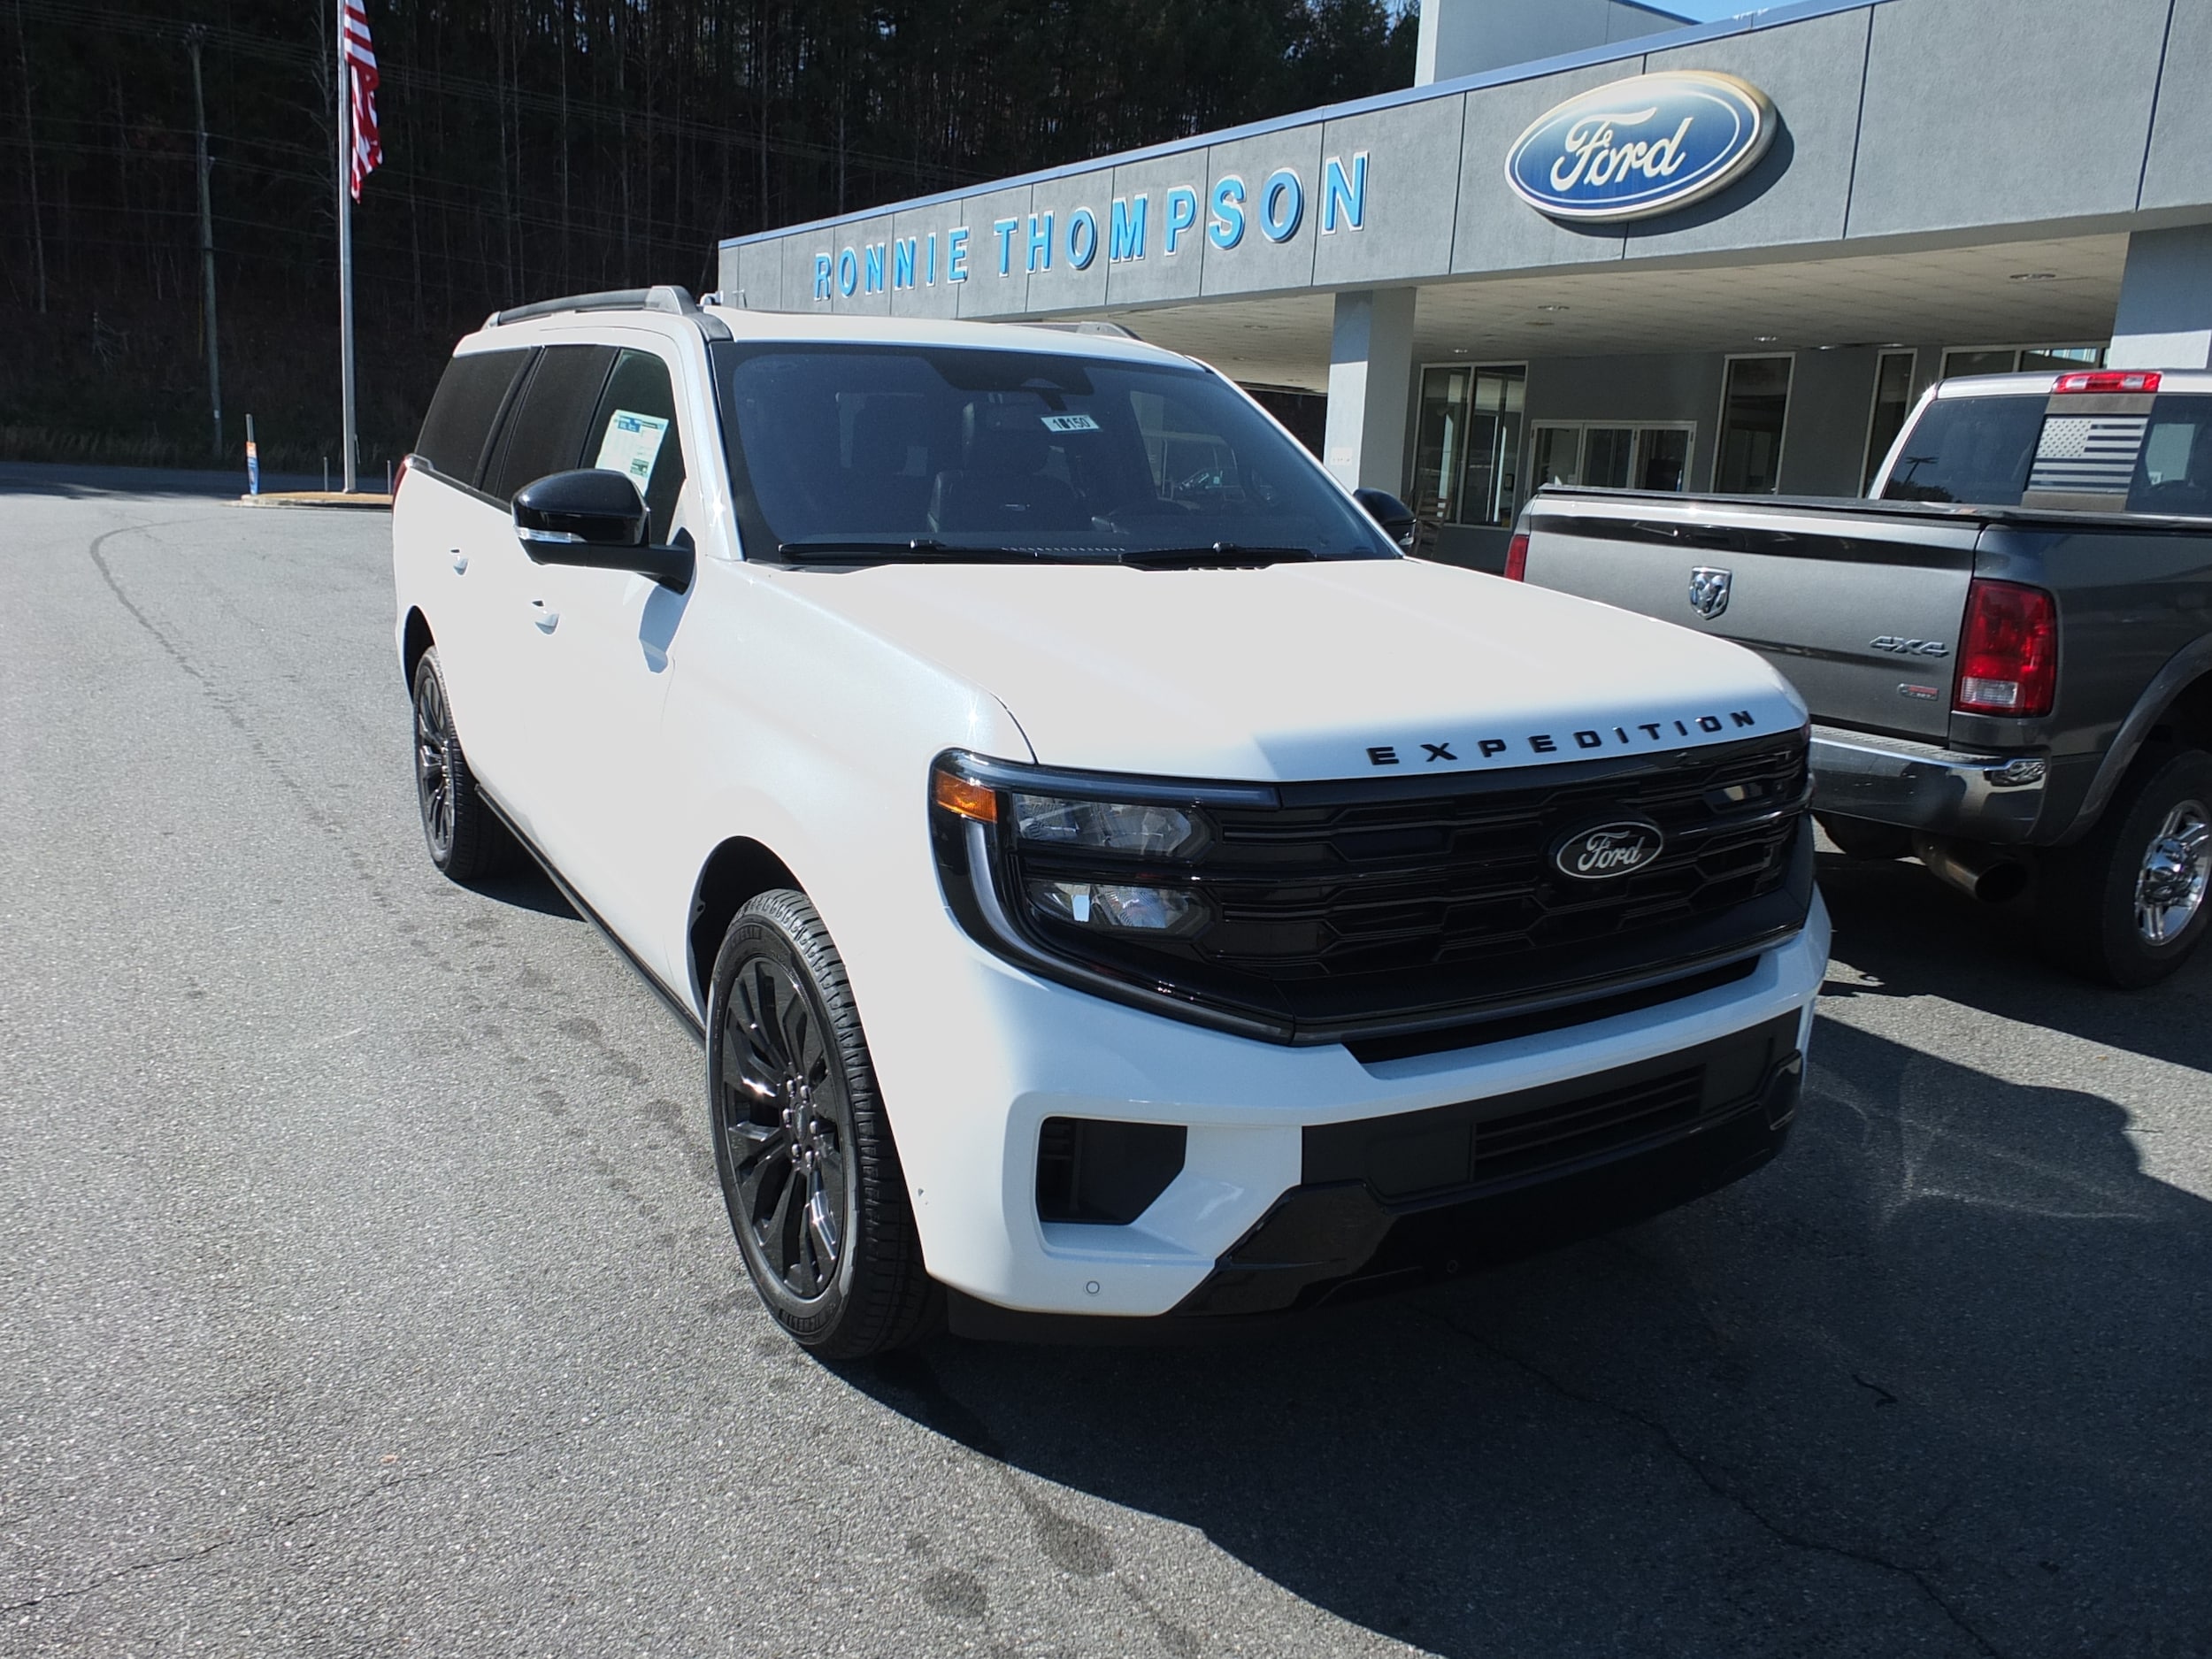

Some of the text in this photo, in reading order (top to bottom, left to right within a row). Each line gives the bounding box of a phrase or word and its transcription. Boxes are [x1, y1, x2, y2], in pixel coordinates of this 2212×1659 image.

[1550, 107, 1694, 191] Ford
[813, 151, 1370, 301] RONNIE THOMPSON
[1366, 710, 1755, 766] EXPEDITION
[1576, 830, 1646, 872] Ford
